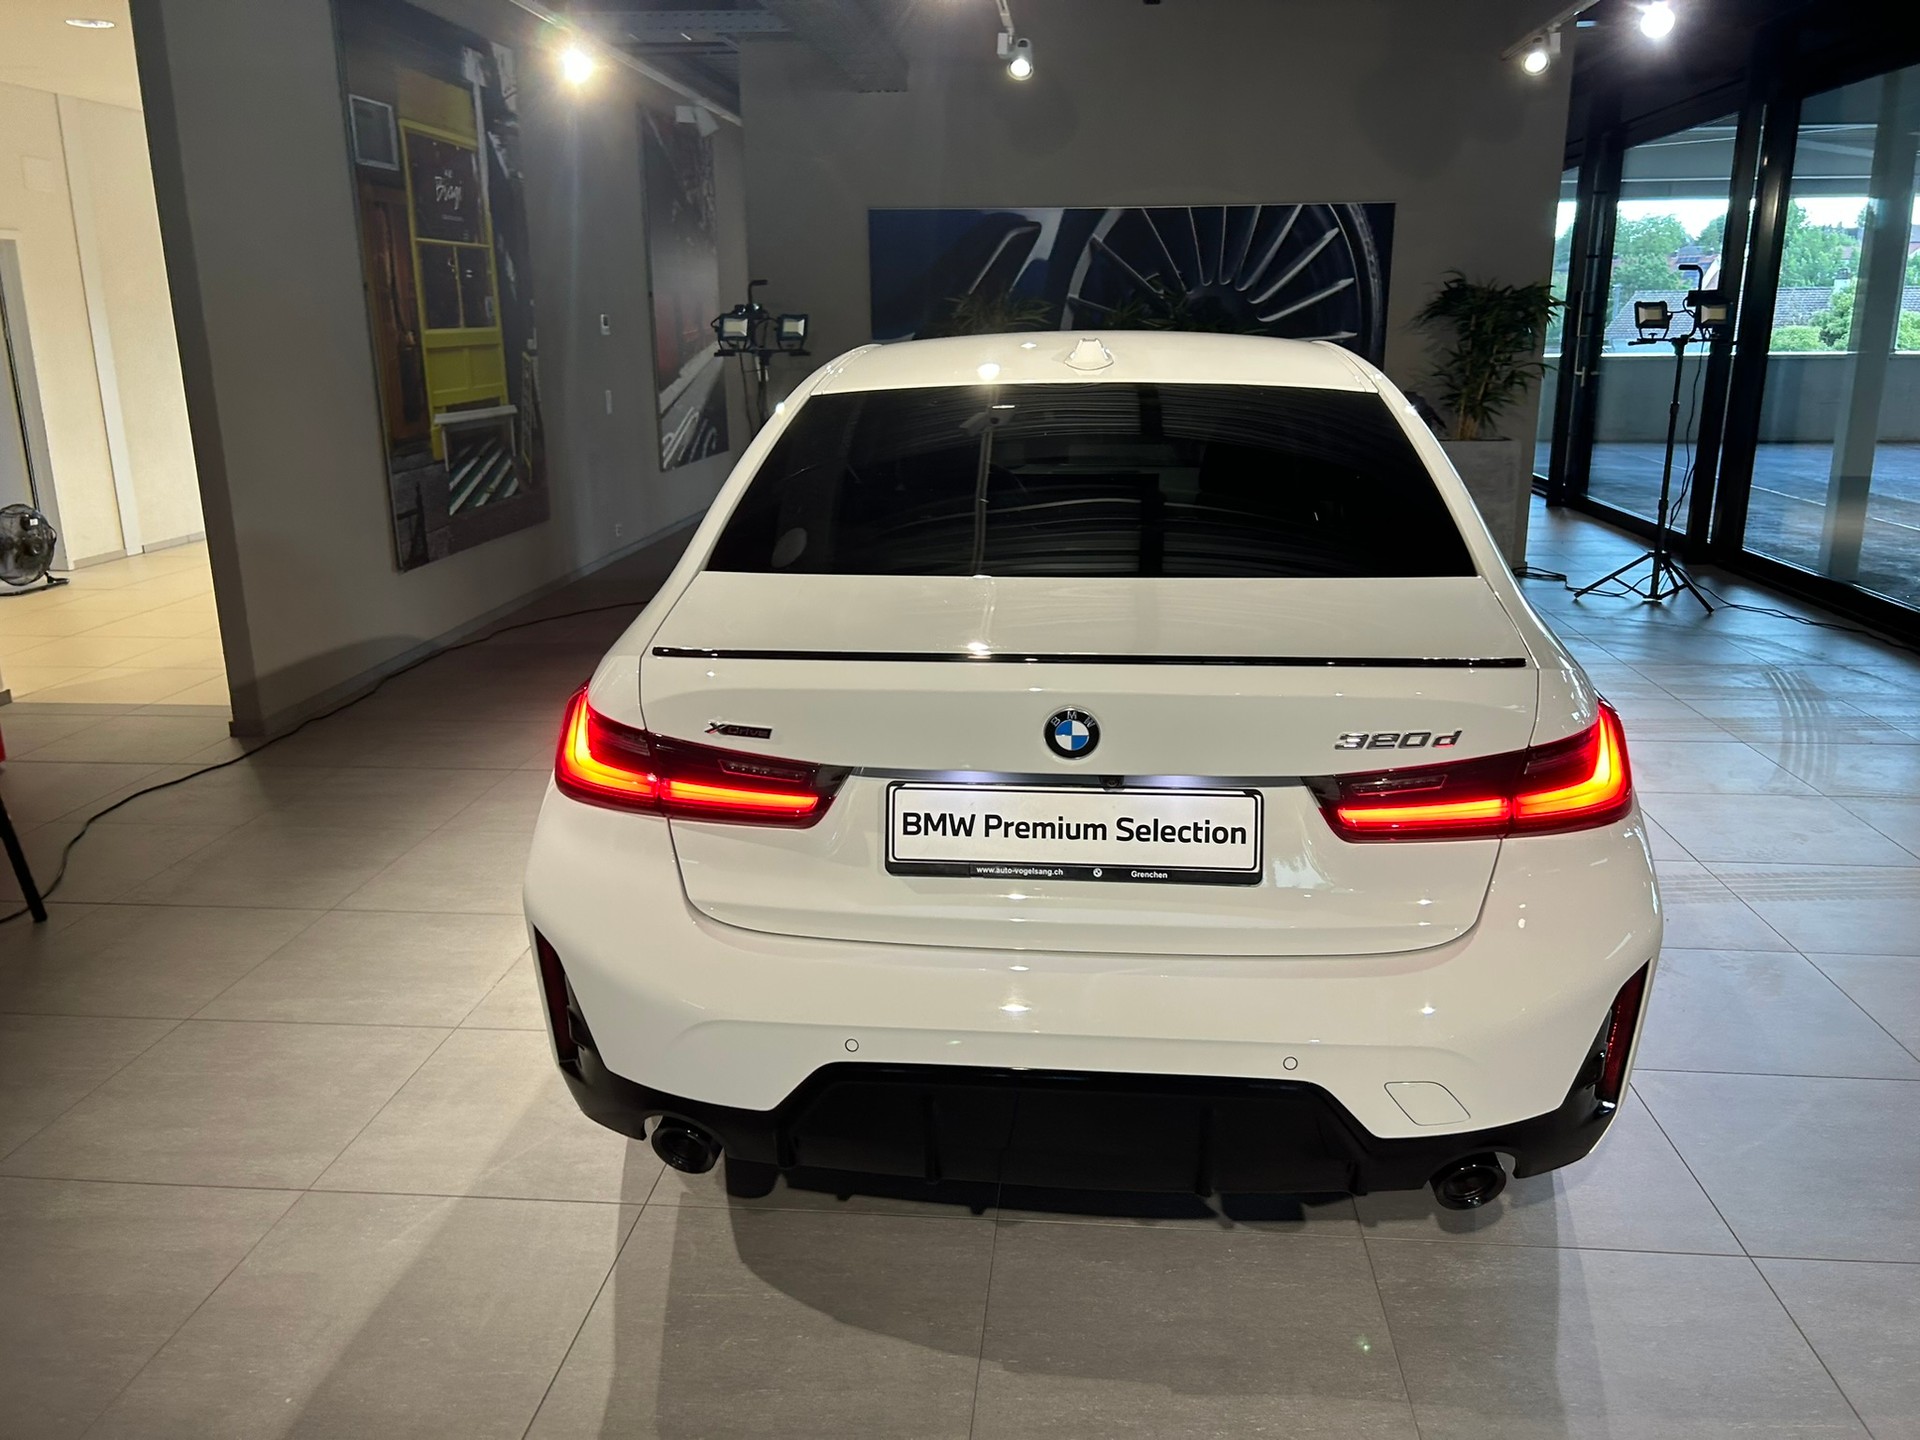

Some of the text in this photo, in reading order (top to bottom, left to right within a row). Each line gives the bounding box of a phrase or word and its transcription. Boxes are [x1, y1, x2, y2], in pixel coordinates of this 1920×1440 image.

[1050, 710, 1096, 728] BMW
[1334, 729, 1463, 750] 320d
[902, 812, 1247, 844] BMW Premium Selection
[976, 866, 1064, 877] www.auto-vogelsang.ch
[1131, 870, 1168, 879] Grenchen
